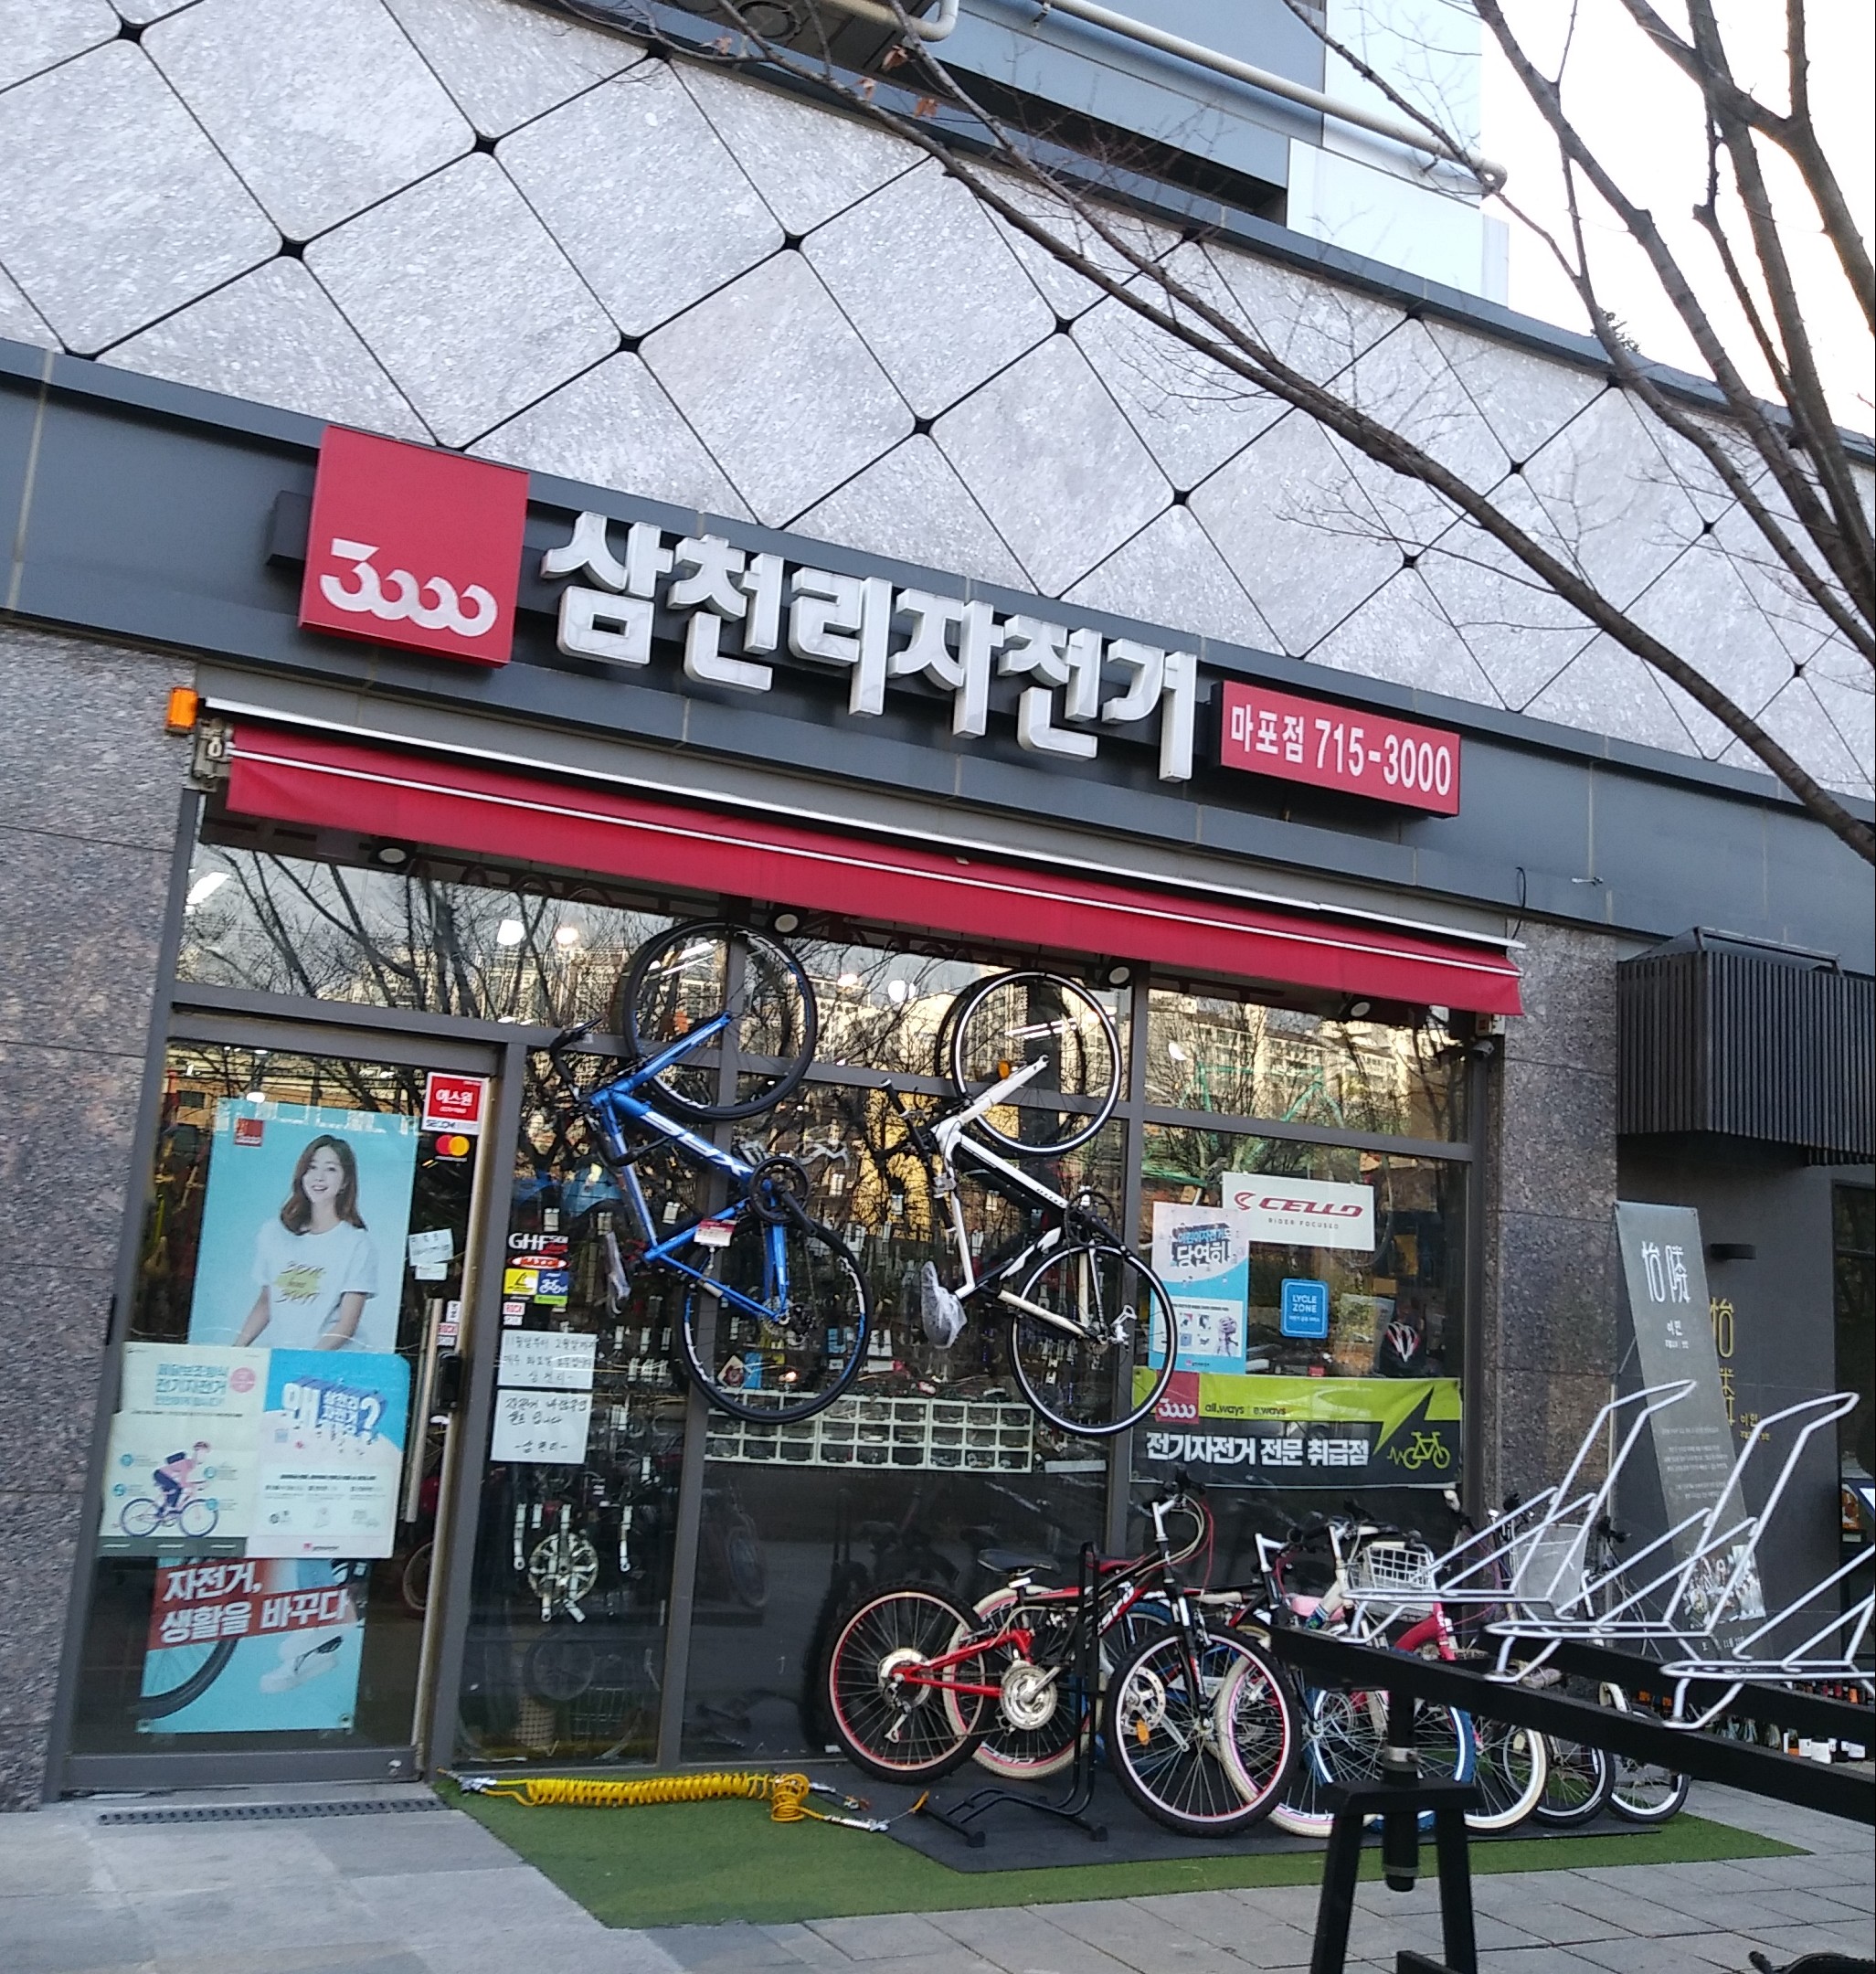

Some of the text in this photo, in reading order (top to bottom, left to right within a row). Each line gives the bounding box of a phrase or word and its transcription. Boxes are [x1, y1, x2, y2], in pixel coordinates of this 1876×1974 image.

[540, 510, 1197, 783] 삼천리자전거
[1230, 704, 1452, 797] 마포점 715-3000
[1258, 1196, 1364, 1218] CELLO
[1291, 1294, 1318, 1304] LYCLE
[1291, 1303, 1318, 1313] ZONE
[1146, 1431, 1370, 1467] 전기자전거 전문 취급점
[163, 1561, 264, 1603] 자전거,
[159, 1587, 351, 1644] 생활을 바꾸다
